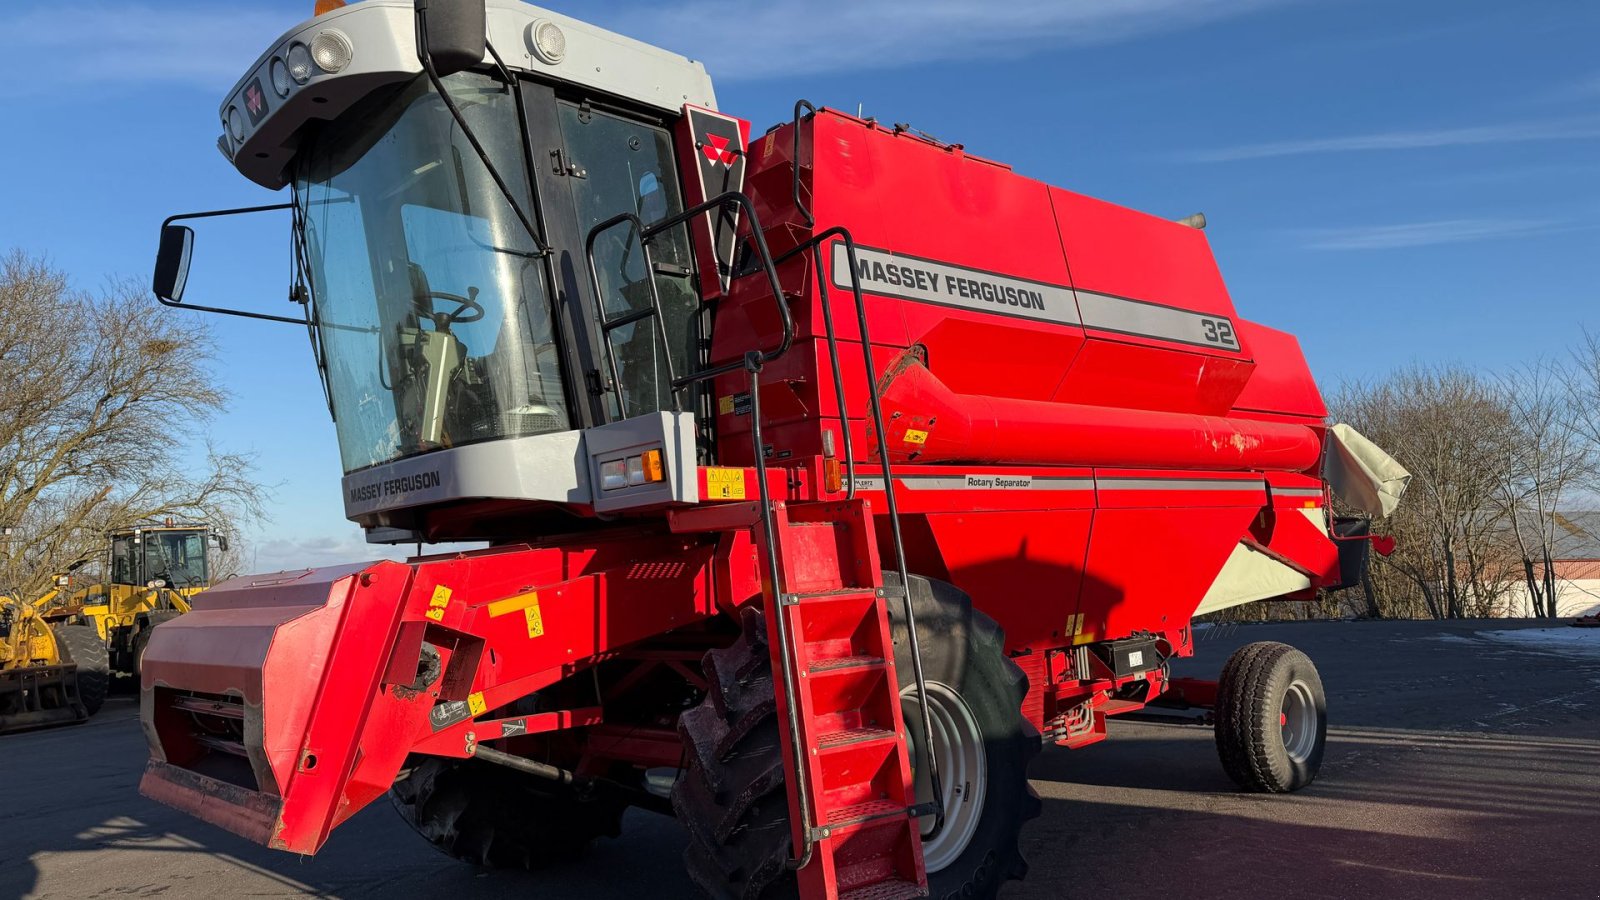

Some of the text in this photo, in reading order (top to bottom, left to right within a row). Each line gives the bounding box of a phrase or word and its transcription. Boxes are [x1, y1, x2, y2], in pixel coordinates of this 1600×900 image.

[855, 258, 1046, 311] MASSEY FERGUSON
[1201, 318, 1235, 346] 32
[350, 470, 441, 503] MASSEY FERGUSON
[967, 477, 1031, 489] Rotary Separator
